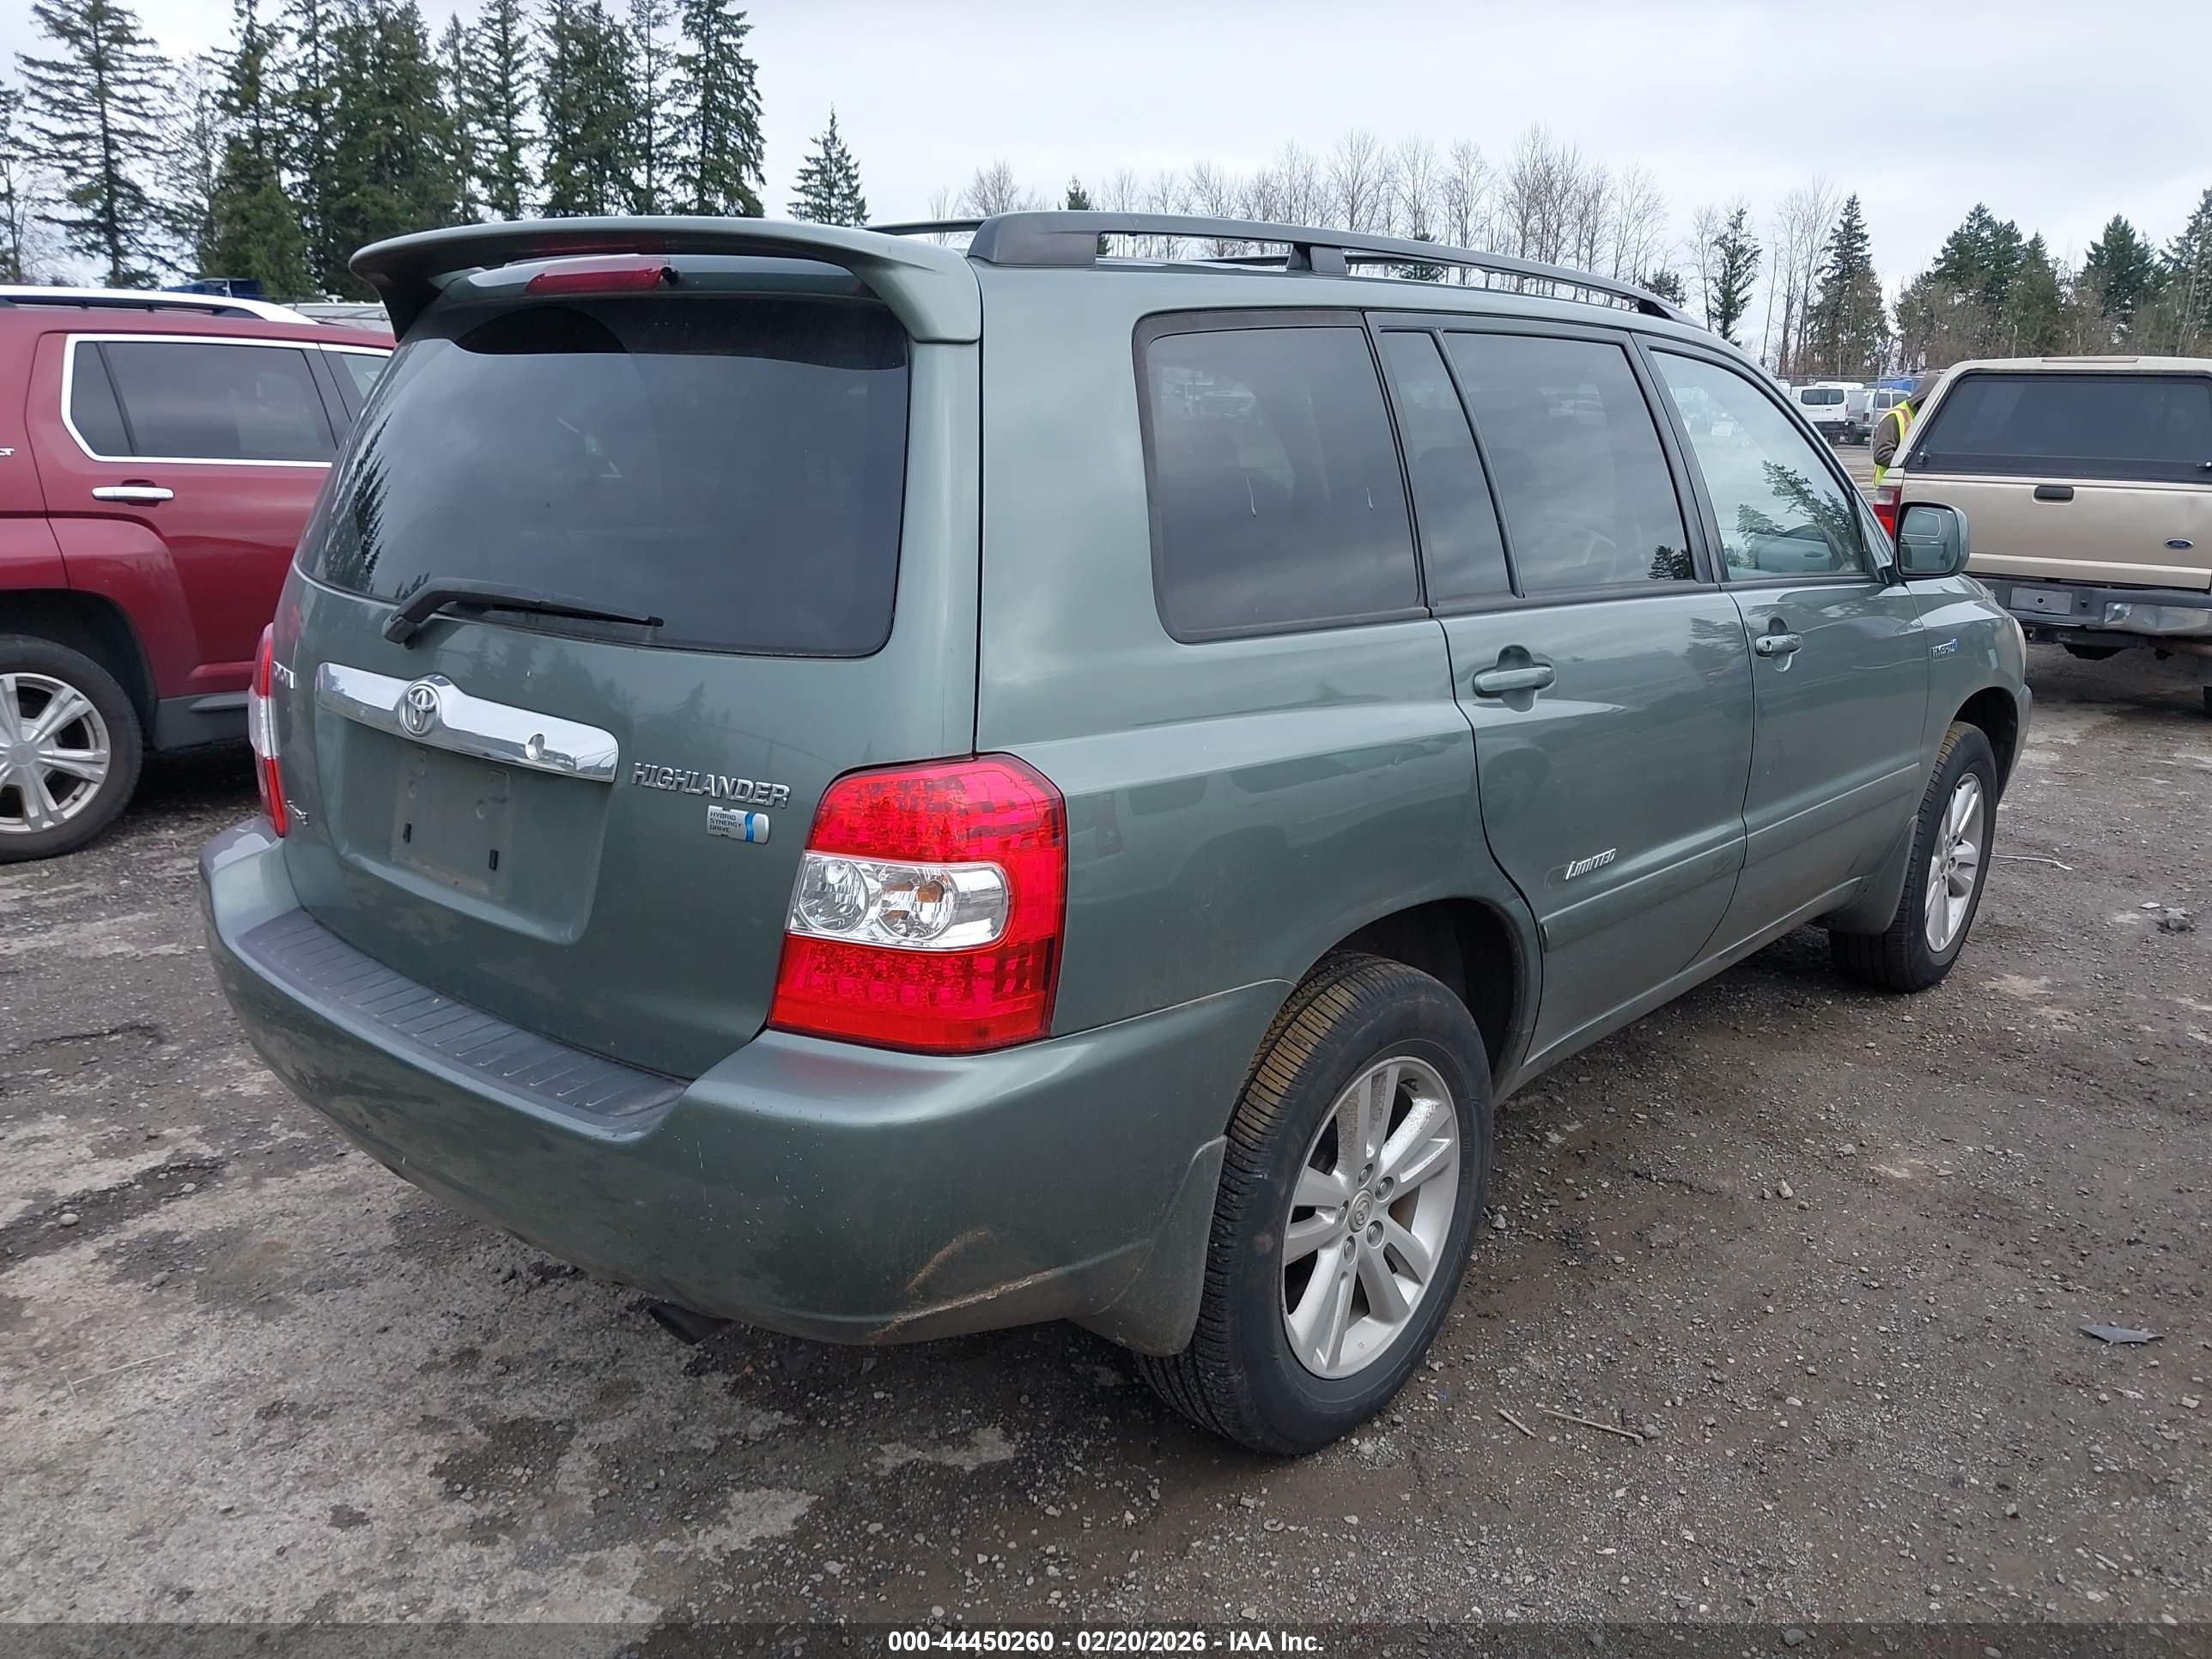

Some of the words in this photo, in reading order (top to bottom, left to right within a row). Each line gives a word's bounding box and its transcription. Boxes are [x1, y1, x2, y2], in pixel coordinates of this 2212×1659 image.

[631, 762, 791, 808] HIGHLANDER
[710, 811, 737, 821] HYBRID
[709, 817, 743, 829] SYNERGY
